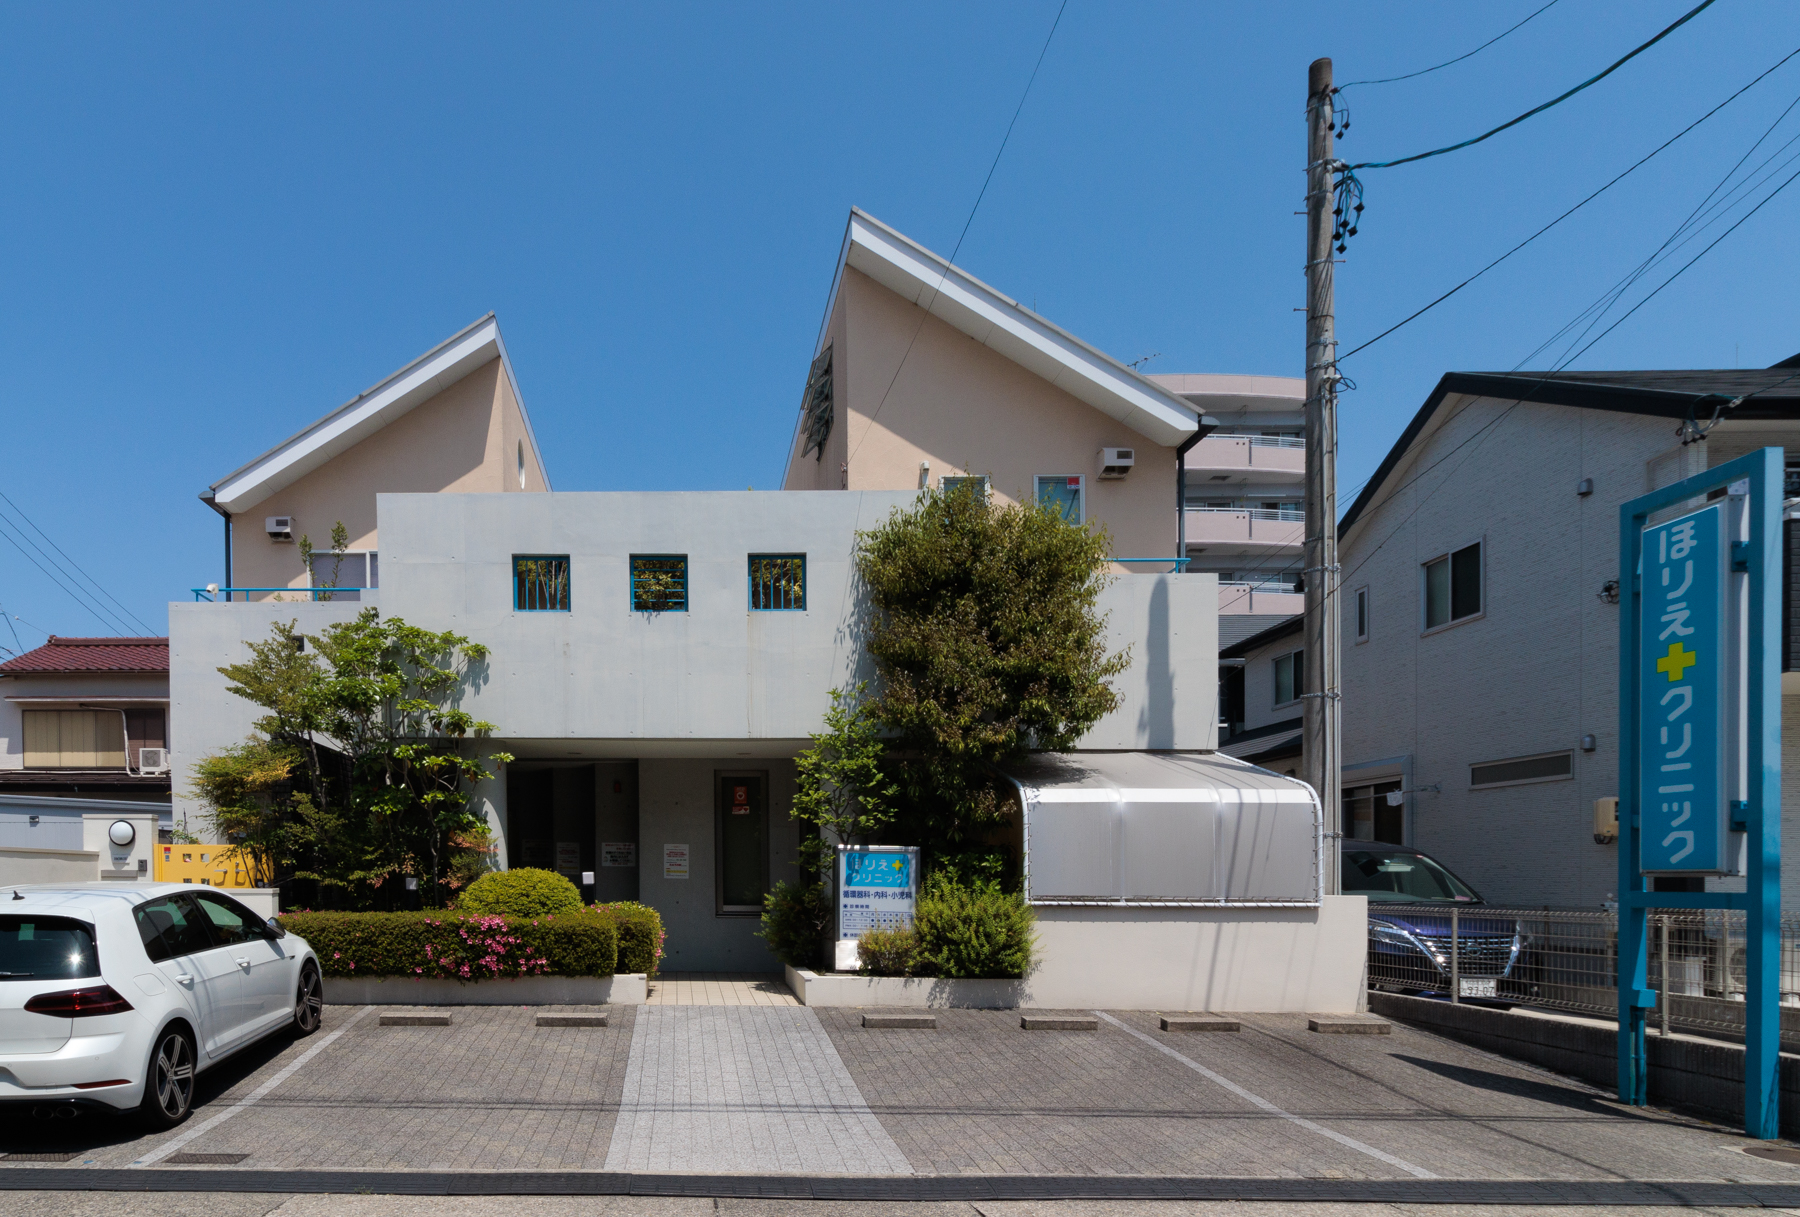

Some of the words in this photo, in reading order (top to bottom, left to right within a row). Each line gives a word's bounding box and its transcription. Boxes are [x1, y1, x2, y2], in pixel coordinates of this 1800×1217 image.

[1659, 520, 1697, 641] ほりえ
[1658, 685, 1694, 864] クリニック
[851, 859, 889, 870] ほりえ
[852, 873, 903, 883] クリニック
